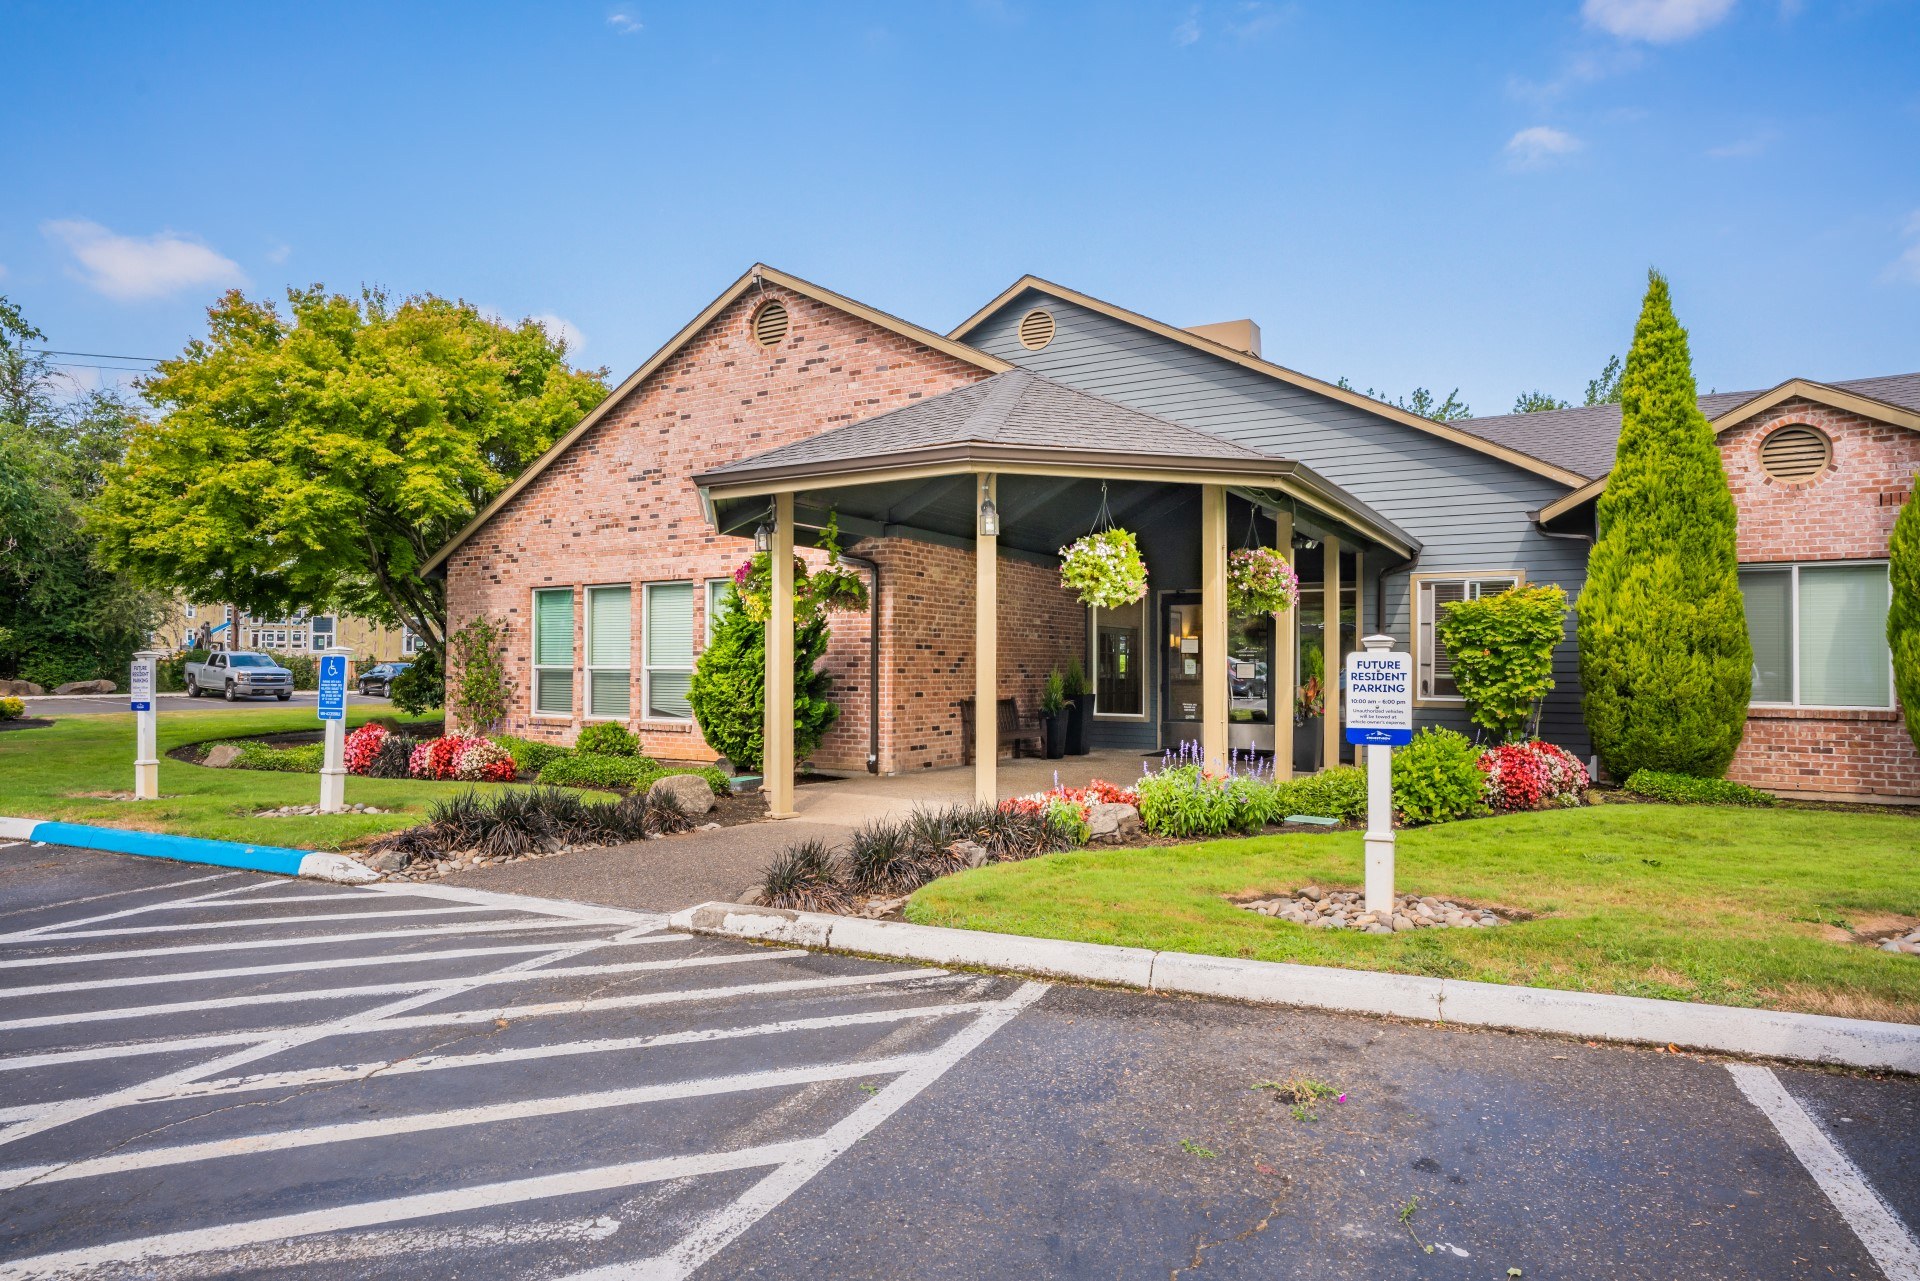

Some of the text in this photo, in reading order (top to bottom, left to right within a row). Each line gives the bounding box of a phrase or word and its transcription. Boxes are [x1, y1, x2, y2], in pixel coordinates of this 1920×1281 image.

[1357, 661, 1400, 669] FUTURE
[1351, 672, 1407, 681] RESIDENT
[1353, 684, 1405, 693] PARKING
